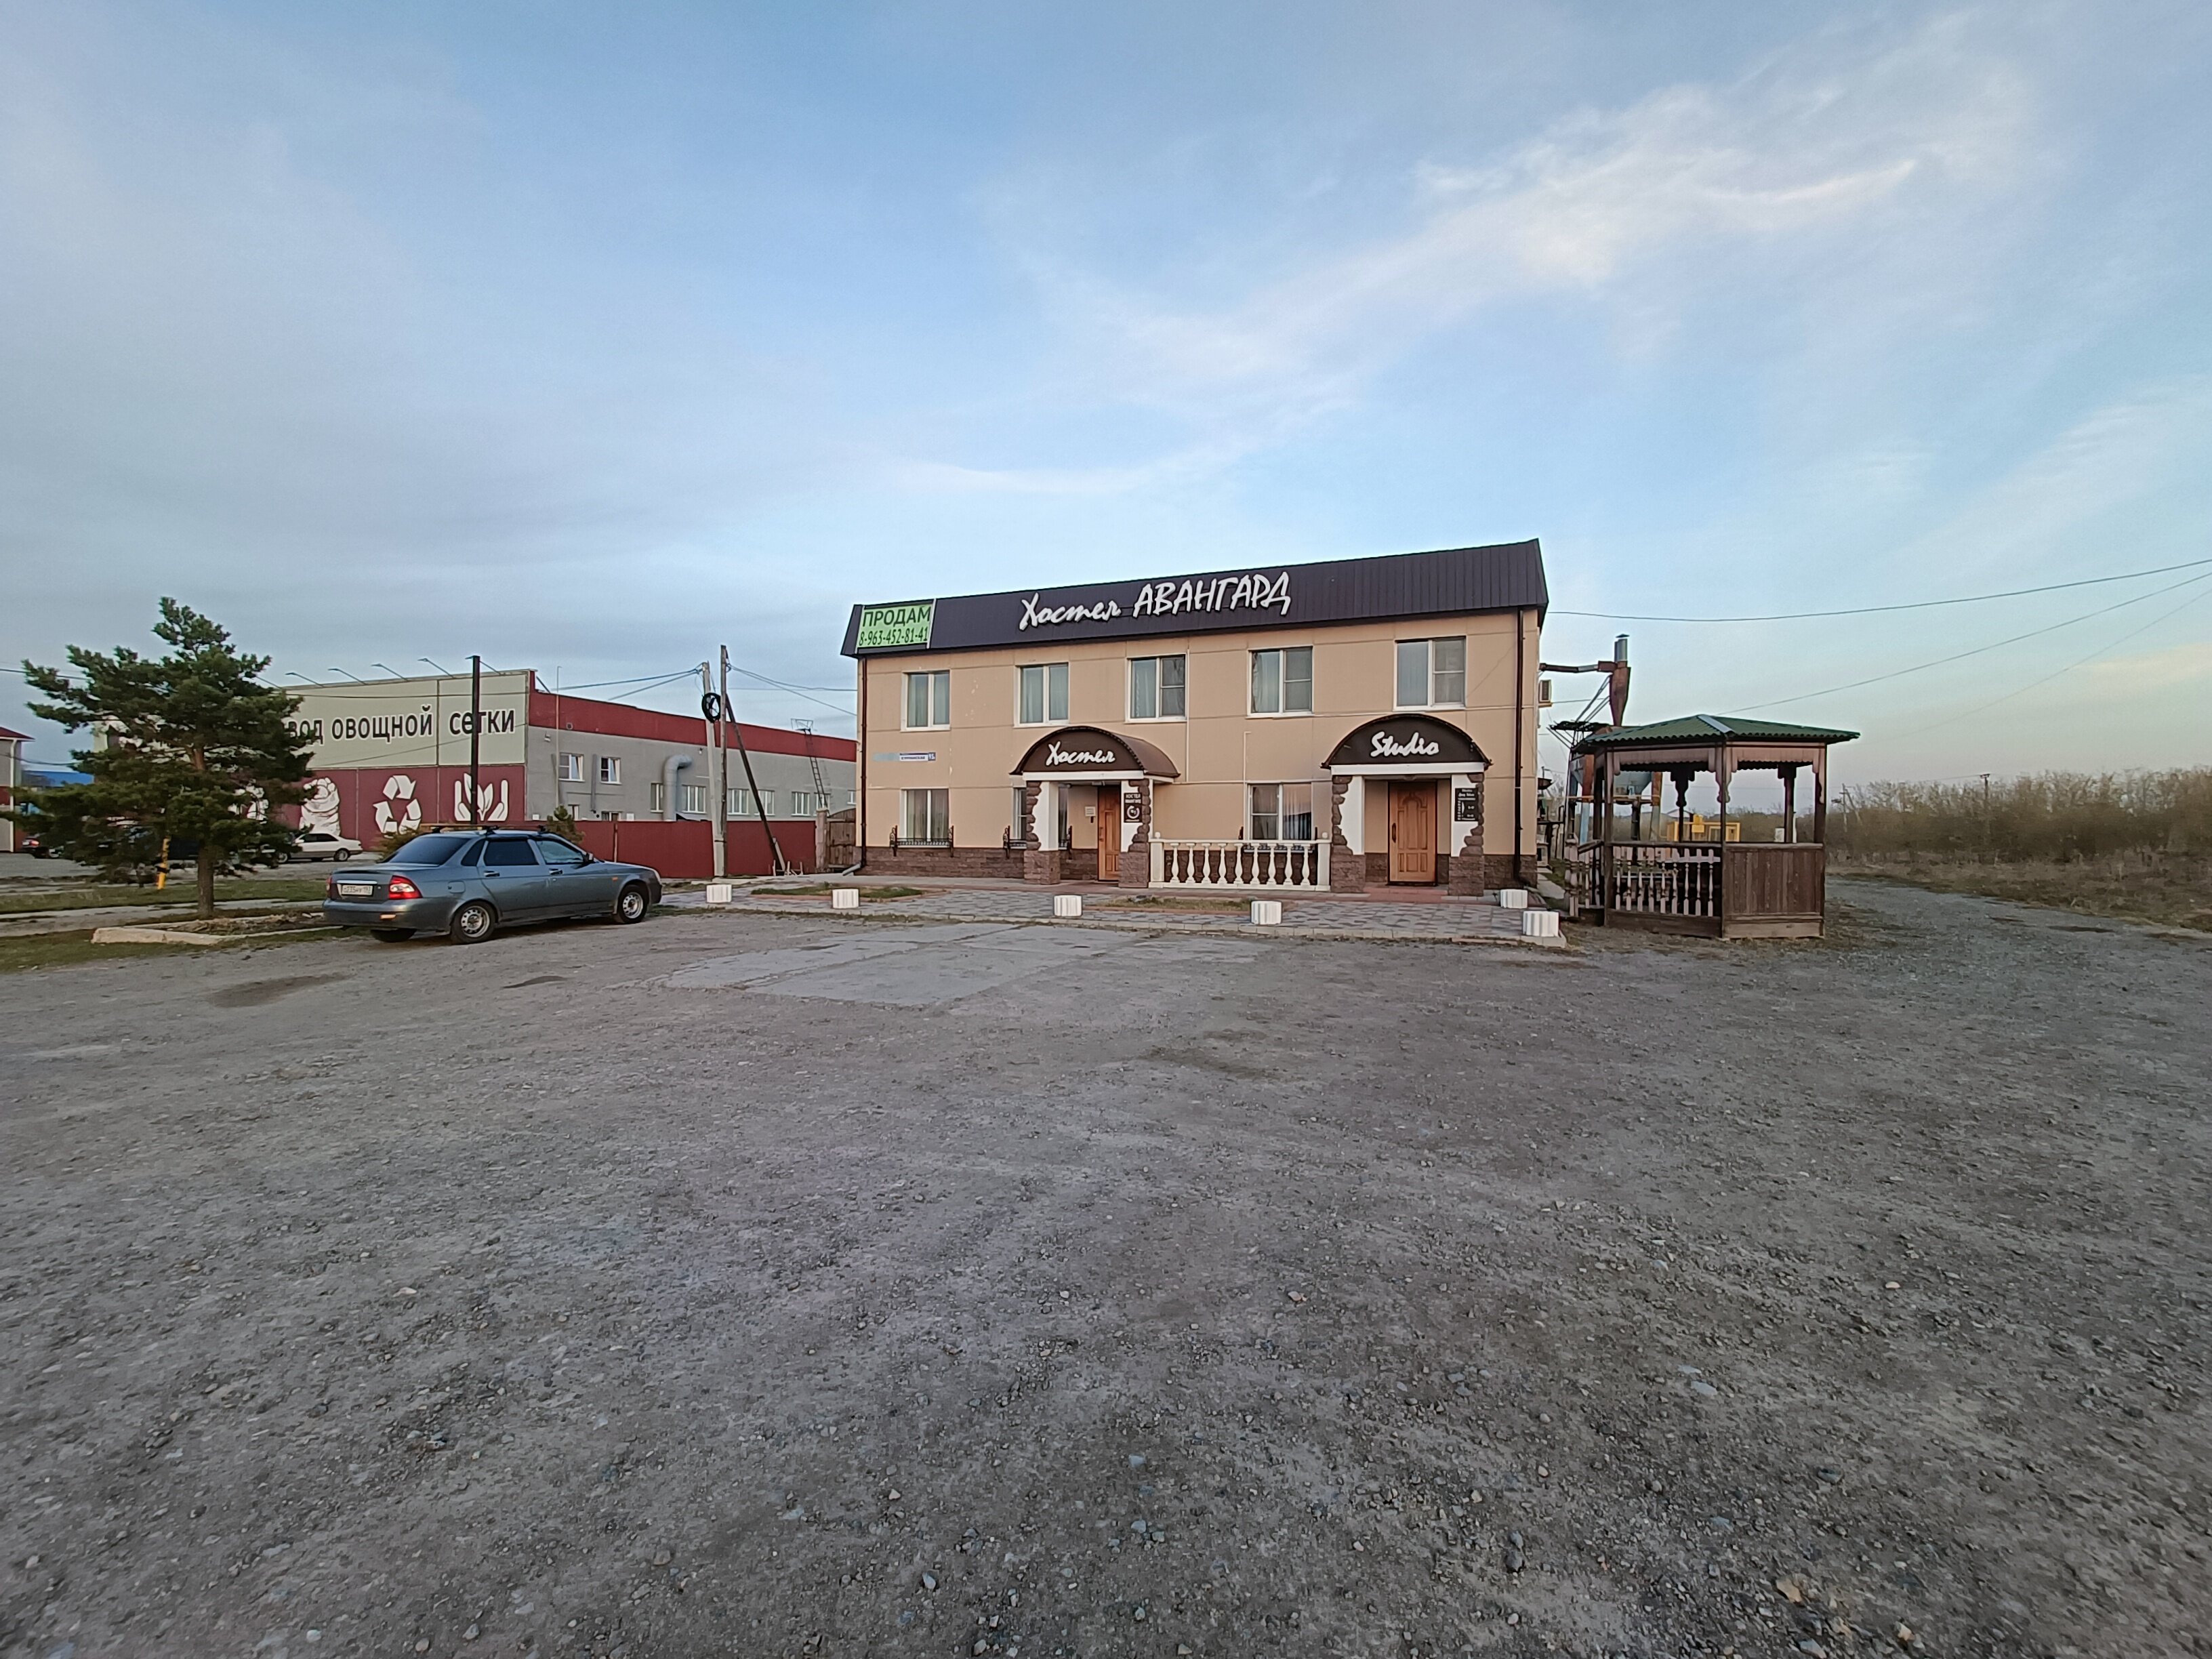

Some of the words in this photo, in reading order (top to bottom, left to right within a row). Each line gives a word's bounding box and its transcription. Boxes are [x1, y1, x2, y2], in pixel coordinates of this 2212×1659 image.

[1019, 592, 1122, 630] Хостел
[1132, 571, 1291, 616] АВАНГАРД
[862, 607, 932, 628] ПРОДАМ
[859, 626, 928, 647] 8-963-452-81-41
[1046, 741, 1115, 766] Хостел
[1370, 731, 1439, 757] Studio
